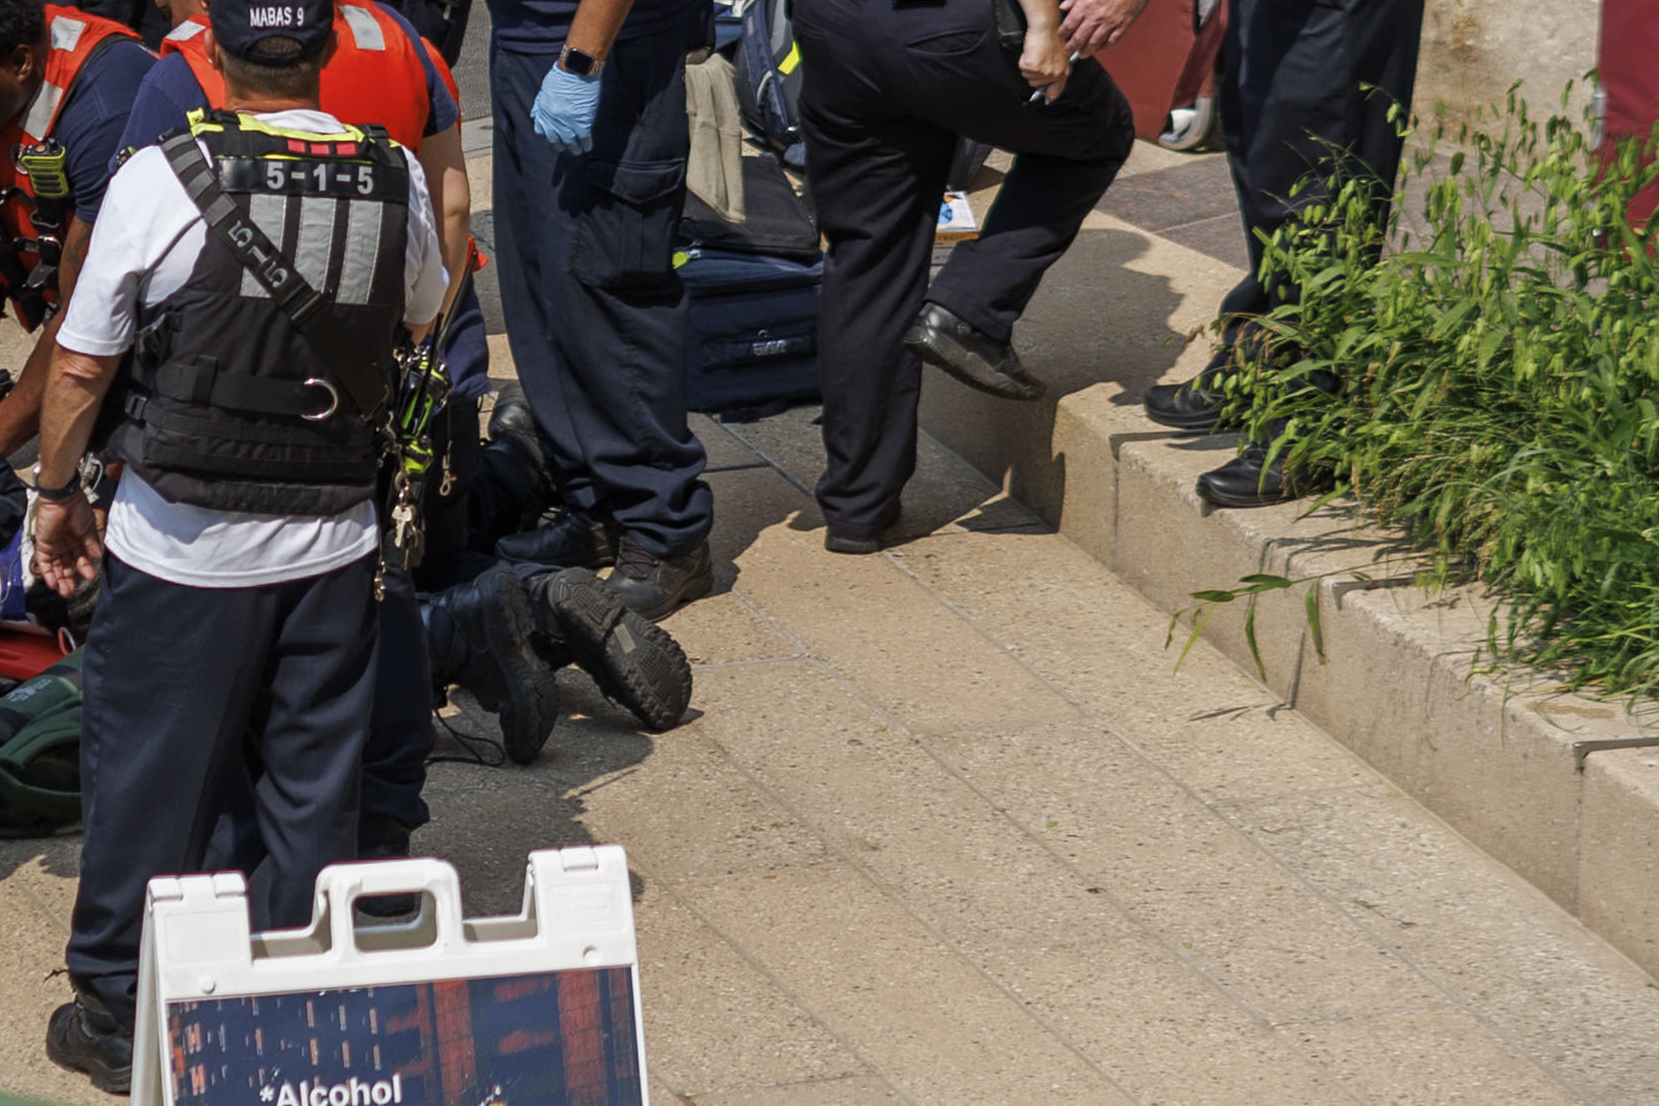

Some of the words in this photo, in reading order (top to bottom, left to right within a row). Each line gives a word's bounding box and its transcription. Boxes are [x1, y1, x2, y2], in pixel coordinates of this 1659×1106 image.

[249, 6, 292, 27] MABAS
[296, 6, 305, 26] 9
[266, 160, 374, 195] 5-1-5
